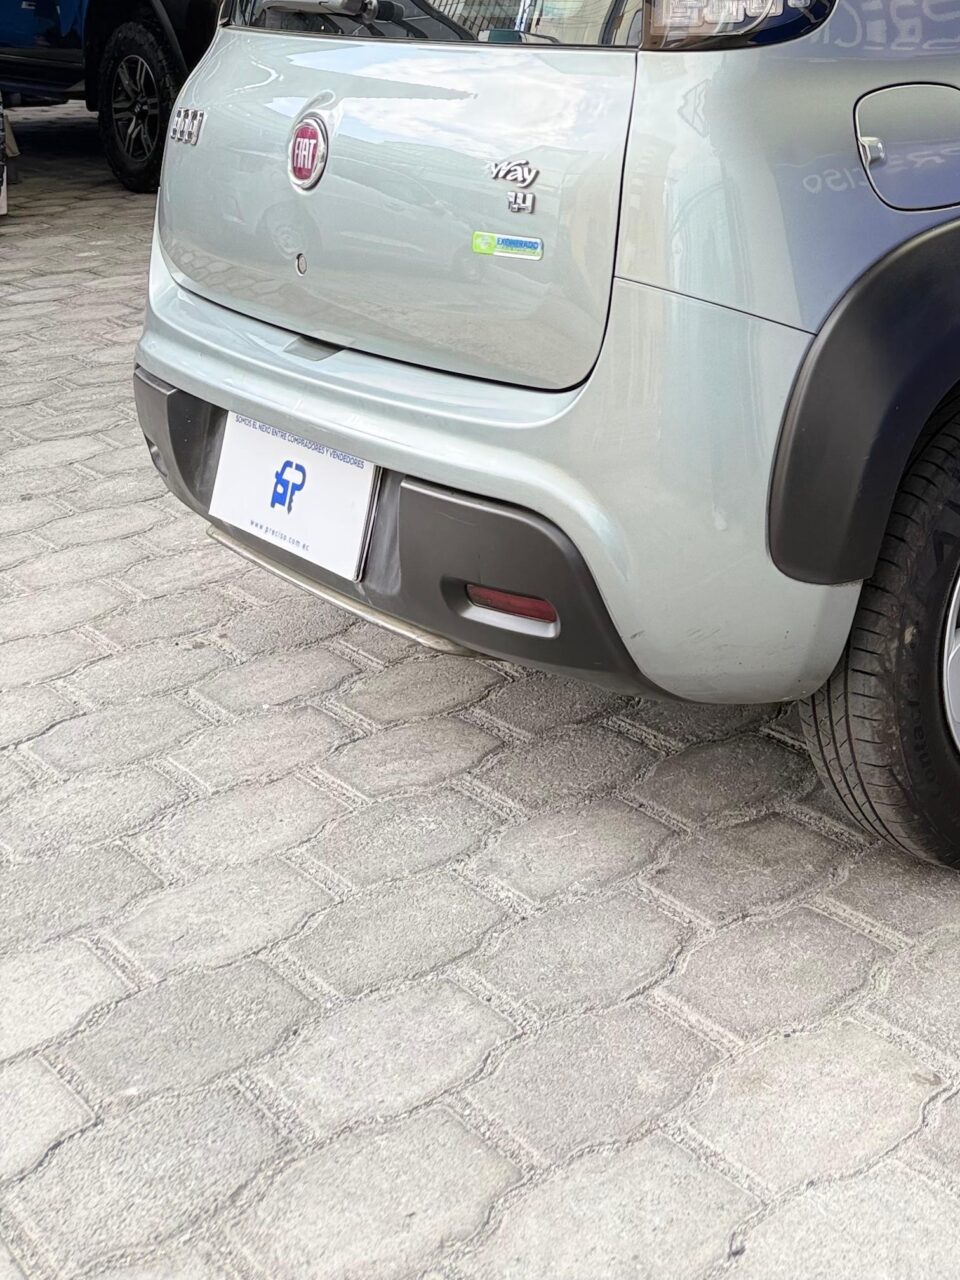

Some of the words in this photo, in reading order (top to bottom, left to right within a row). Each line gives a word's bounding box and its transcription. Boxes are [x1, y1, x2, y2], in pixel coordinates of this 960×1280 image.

[293, 138, 316, 169] FIAT
[487, 159, 540, 189] Way
[235, 415, 252, 428] SOMOS
[252, 420, 258, 429] EL
[258, 423, 271, 435] NEXO
[271, 427, 287, 440] ENTRE
[287, 432, 325, 455] COMPRADORES
[329, 448, 365, 469] VENDEDORES
